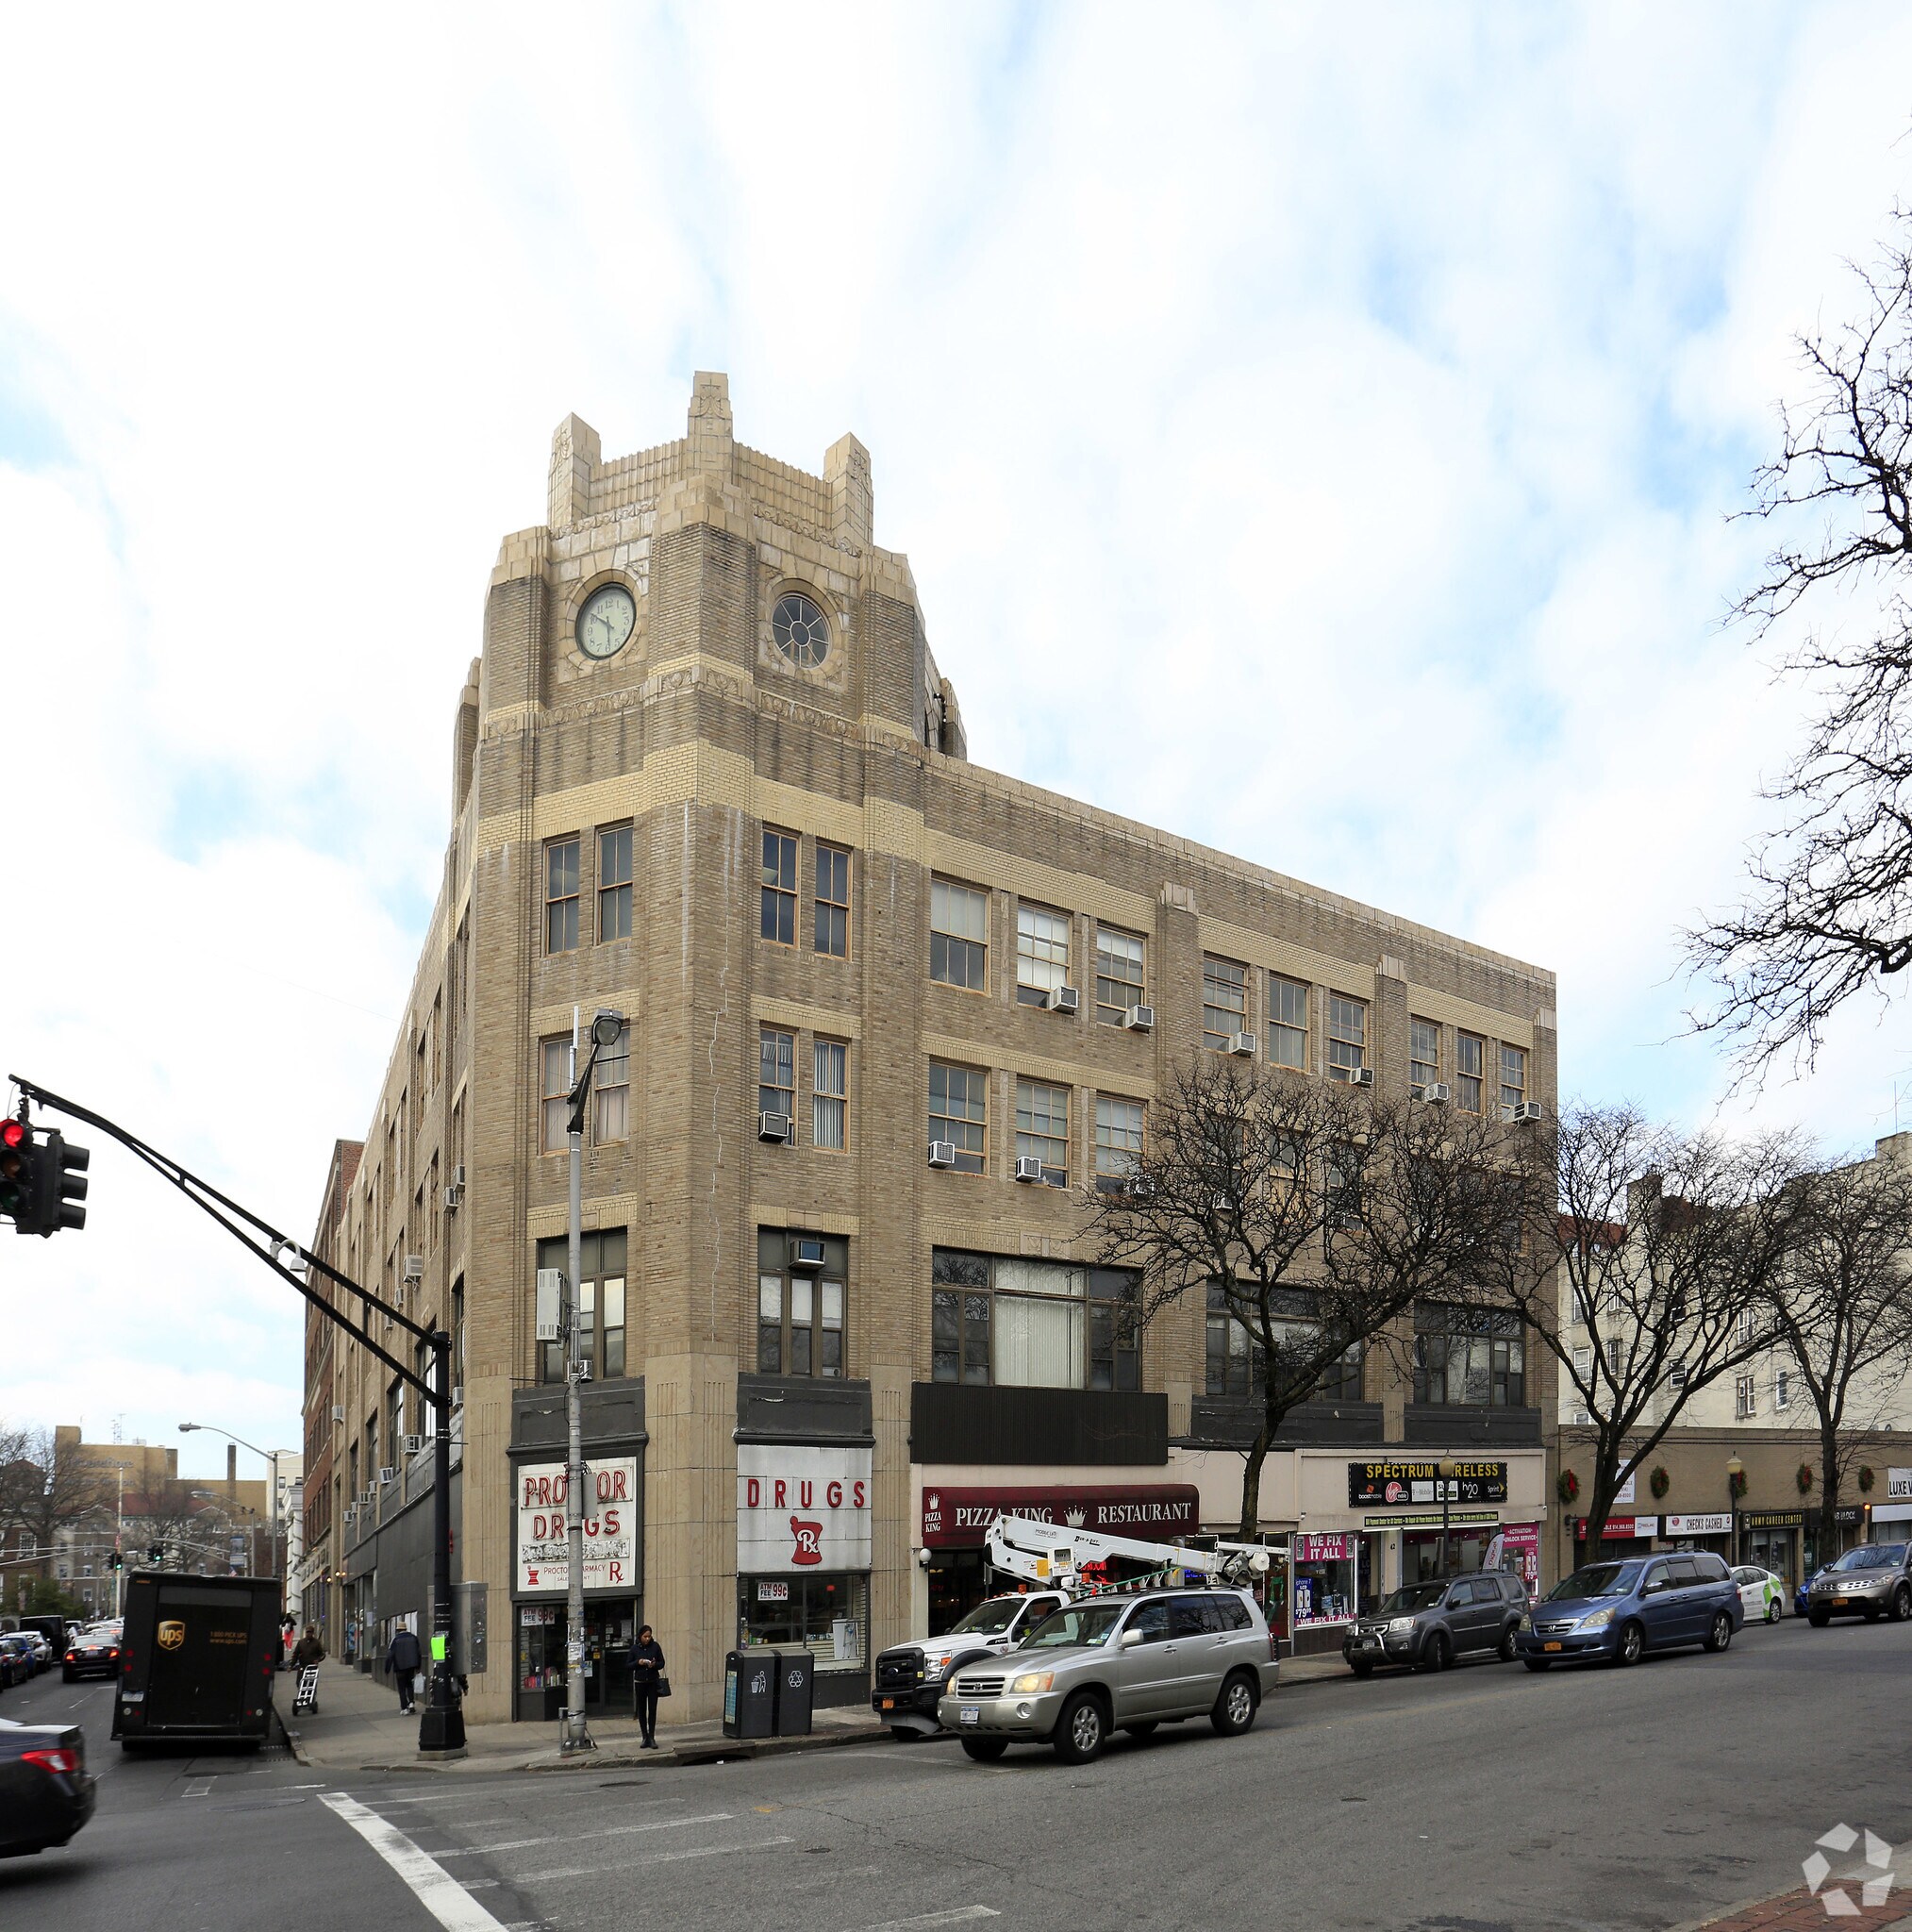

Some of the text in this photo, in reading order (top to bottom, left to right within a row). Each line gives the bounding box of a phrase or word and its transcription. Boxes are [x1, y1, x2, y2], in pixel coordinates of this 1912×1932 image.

[605, 597, 614, 609] 12
[616, 599, 620, 609] 1
[596, 605, 604, 615] 11
[622, 605, 628, 615] 2
[623, 615, 630, 625] 3
[587, 626, 593, 636] 9
[620, 628, 626, 638] 4
[589, 637, 595, 646] 8
[614, 638, 621, 647] 5
[596, 642, 603, 653] 7
[605, 642, 611, 653] 6
[1366, 1463, 1499, 1478] SPECTRUM RELESS
[524, 1470, 626, 1507] PROOR
[747, 1478, 865, 1508] DRUGS
[1889, 1481, 1906, 1495] LUXE
[924, 1511, 941, 1523] PIZZA
[1097, 1503, 1191, 1524] RESTAURANT
[533, 1509, 621, 1540] DRGS
[1687, 1517, 1722, 1530] CHECKS CASHED
[1752, 1514, 1802, 1526] ARMY CAREER CENTER
[925, 1522, 941, 1533] KING
[1309, 1536, 1323, 1547] WE
[1327, 1535, 1342, 1546] FIX
[1310, 1548, 1321, 1559] IT
[1322, 1548, 1340, 1559] ALL
[544, 1566, 569, 1575] PROCTO
[1300, 1612, 1351, 1625] WE FIX IT ALL
[160, 1630, 183, 1645] ups
